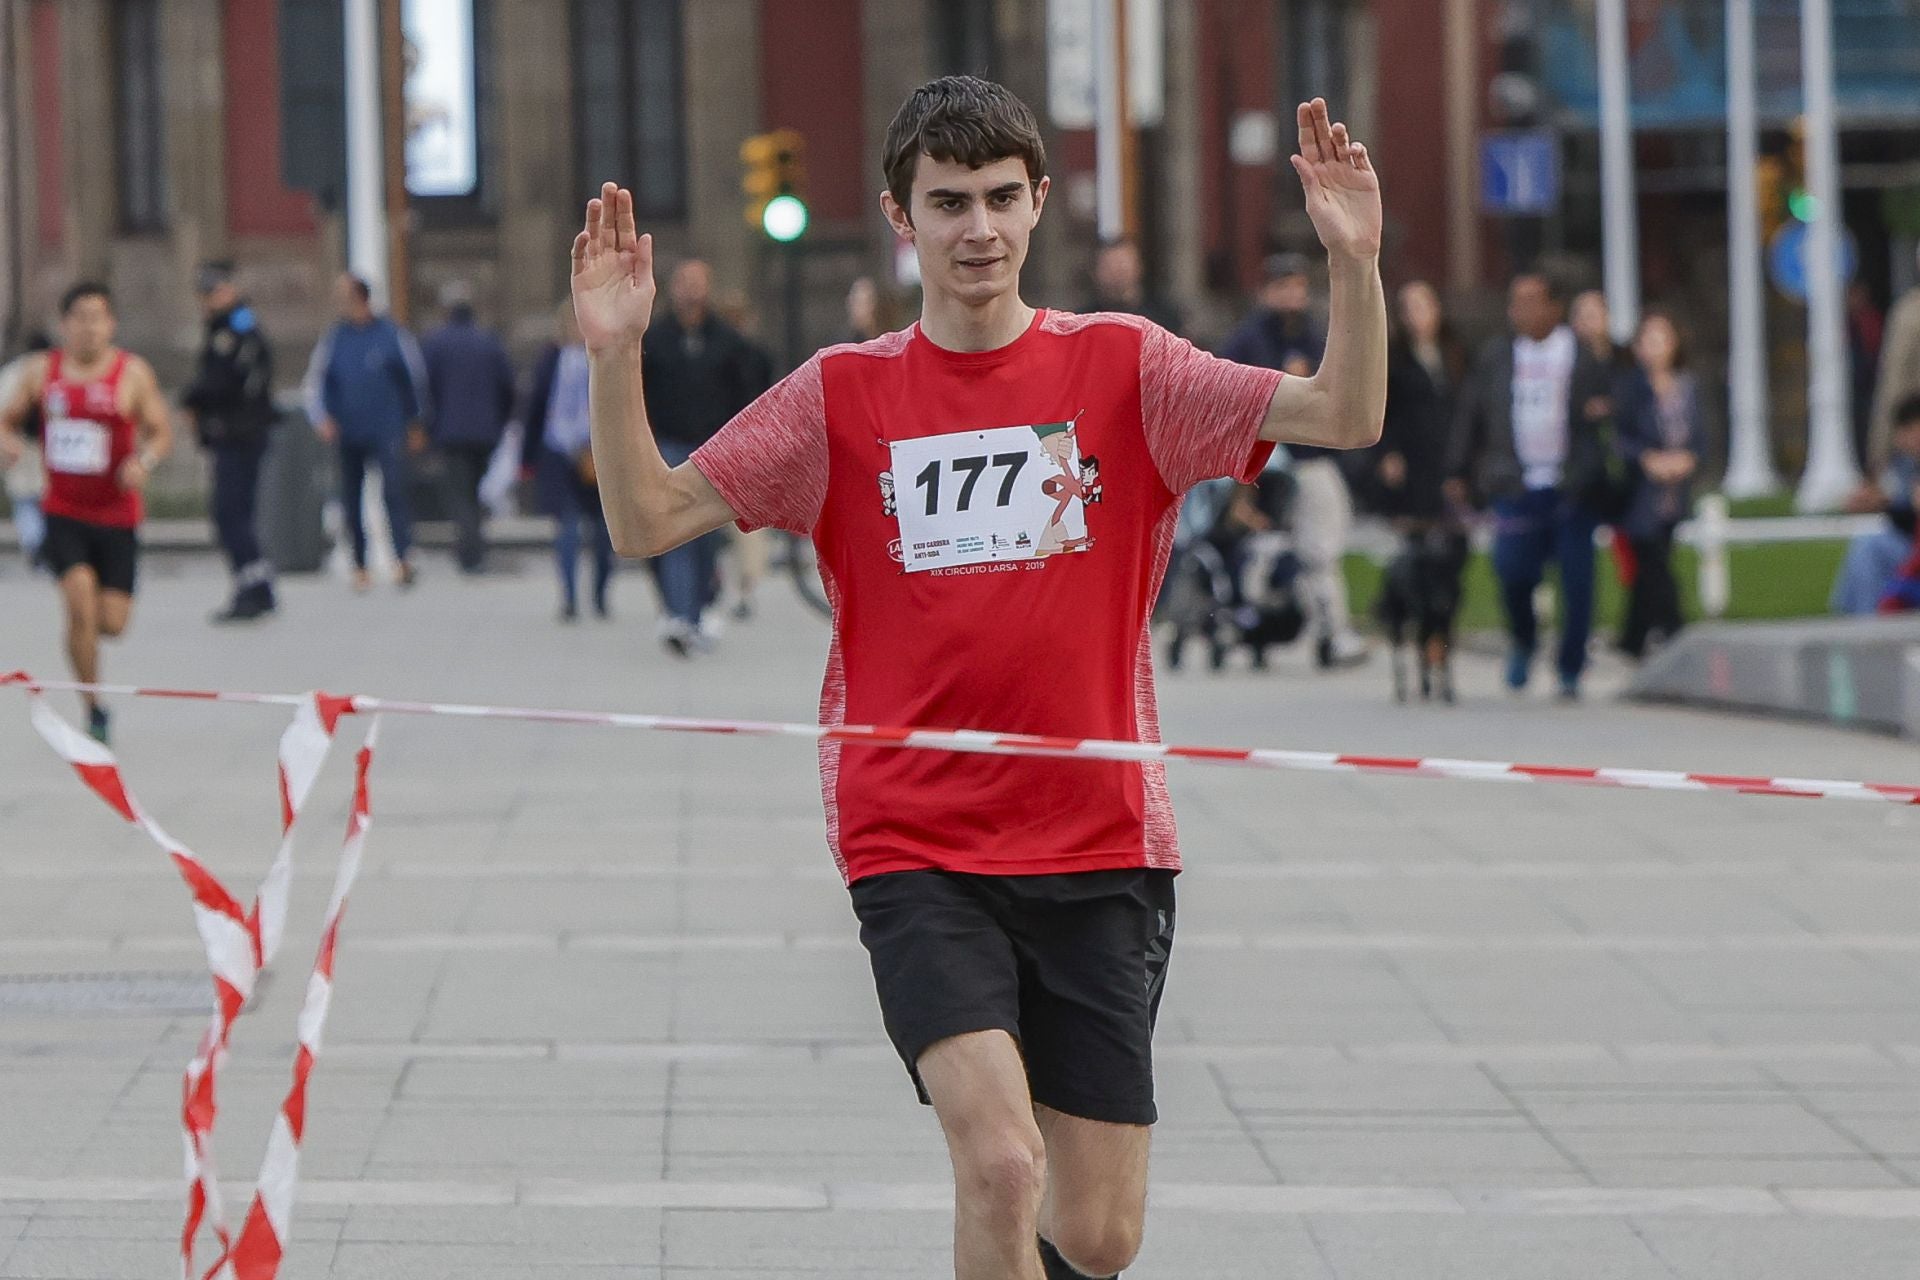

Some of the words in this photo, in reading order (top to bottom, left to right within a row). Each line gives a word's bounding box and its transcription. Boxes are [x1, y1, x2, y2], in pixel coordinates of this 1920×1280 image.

[915, 451, 1028, 516] 177
[930, 568, 944, 577] XIX
[944, 565, 987, 576] CIRCUITO
[988, 563, 1018, 573] LARSA
[1025, 561, 1045, 571] 2019
